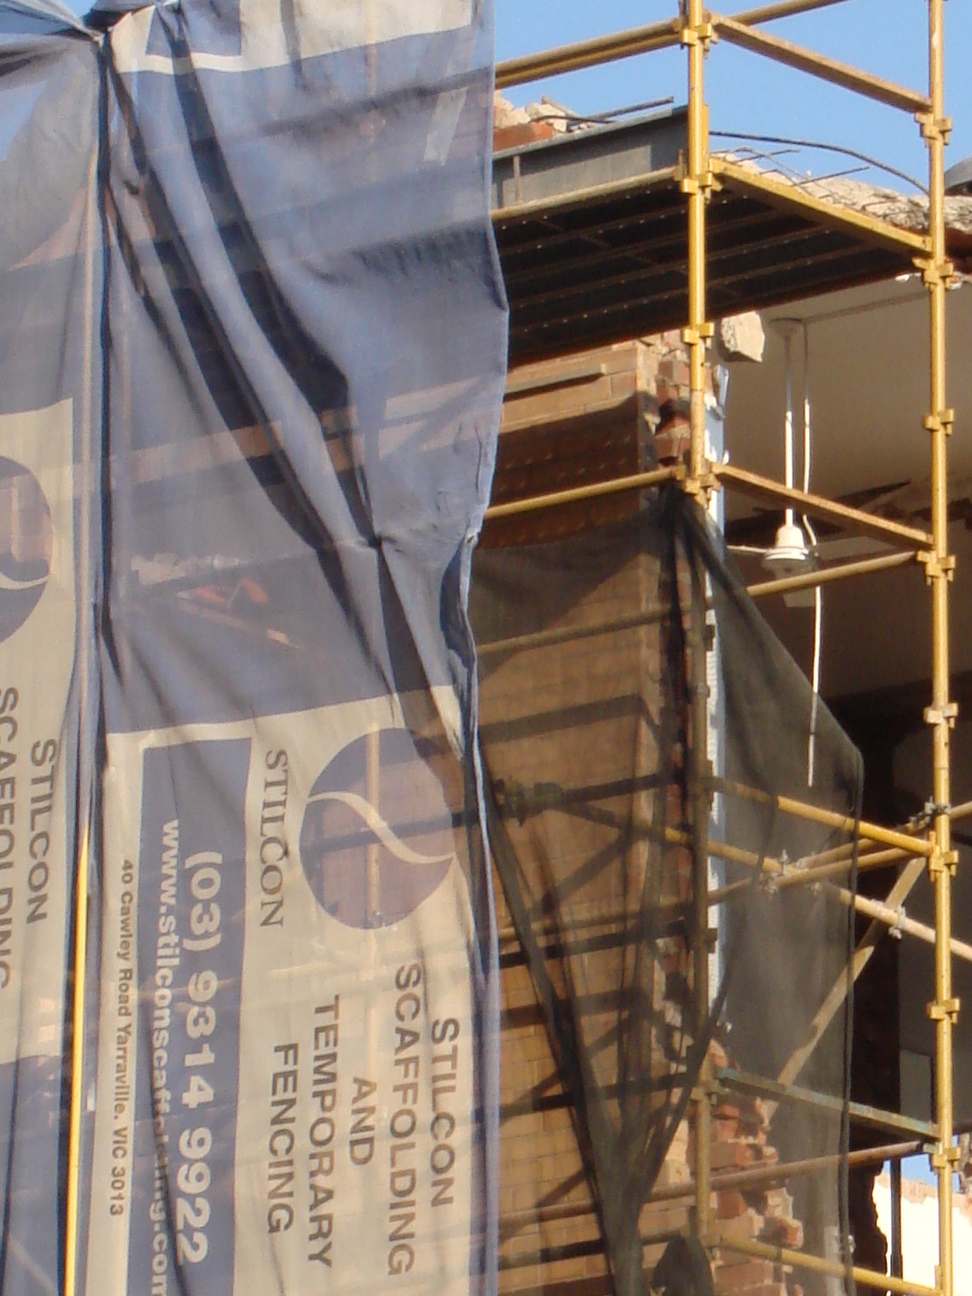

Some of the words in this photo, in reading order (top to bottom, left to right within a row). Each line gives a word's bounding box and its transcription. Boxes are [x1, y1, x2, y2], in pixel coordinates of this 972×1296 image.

[26, 739, 57, 924] STILCON
[121, 859, 134, 884] 40
[259, 749, 289, 928] STILCON
[117, 891, 134, 961] Cawley
[184, 852, 223, 951] (03)
[117, 969, 133, 1016] Road
[180, 970, 218, 1109] 9314
[112, 1127, 128, 1159] VIC
[267, 1044, 298, 1235] FENCING
[308, 996, 339, 1268] TEMPORARY
[349, 1077, 376, 1166] AND
[387, 963, 421, 1276] SCAFFOLDING
[429, 1018, 459, 1205] STILCON
[109, 1166, 126, 1216] 3013
[175, 1128, 210, 1264] 9922
